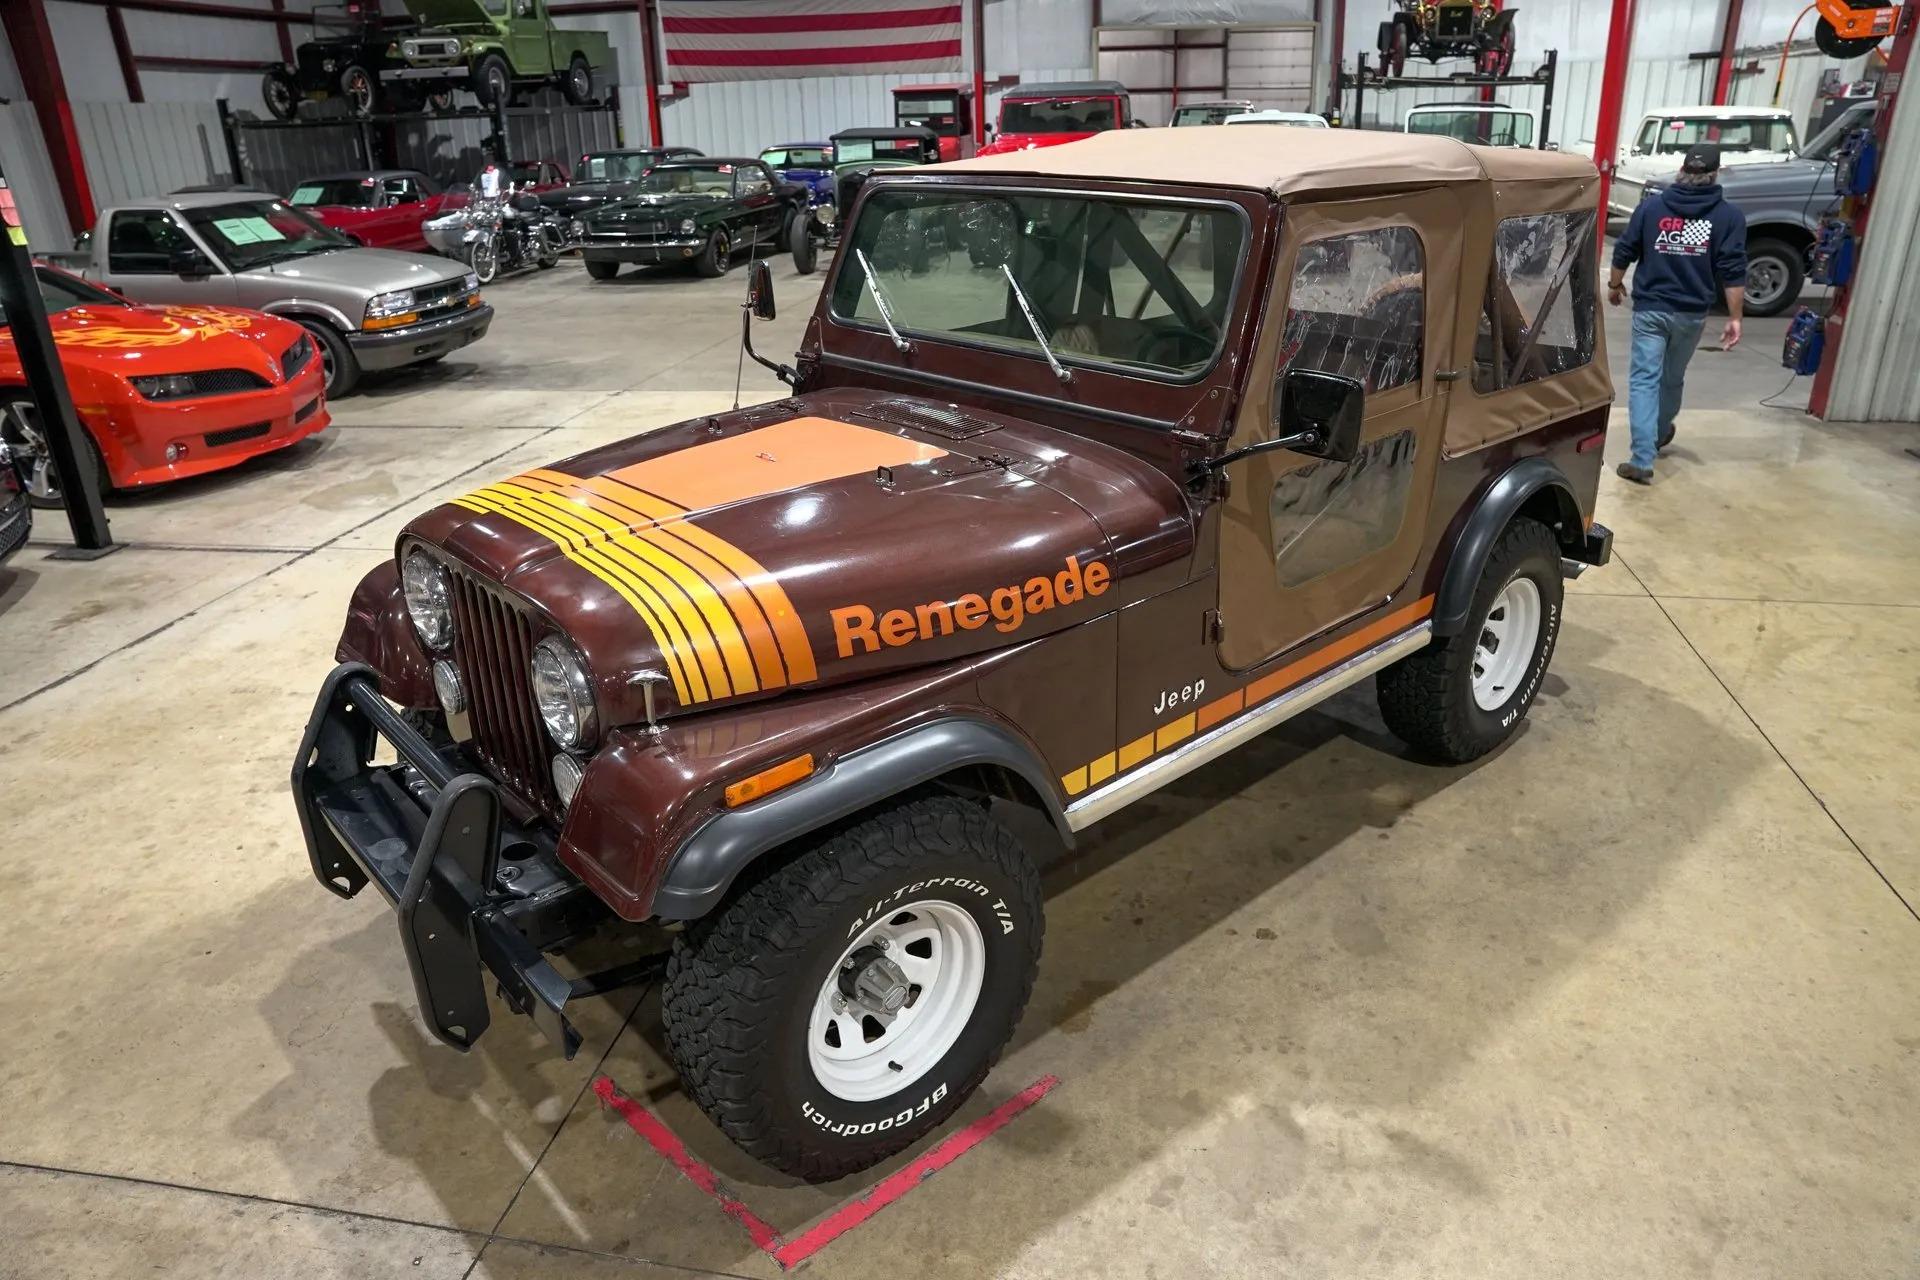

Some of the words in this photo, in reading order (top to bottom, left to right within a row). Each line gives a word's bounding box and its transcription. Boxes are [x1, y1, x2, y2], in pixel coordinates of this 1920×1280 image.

[1655, 230, 1681, 244] AG
[1658, 217, 1683, 230] GR
[830, 555, 1110, 658] Renegade
[1153, 679, 1205, 715] Jeep
[846, 877, 990, 939] All-Terrain
[801, 1082, 949, 1137] BFGoodrich
